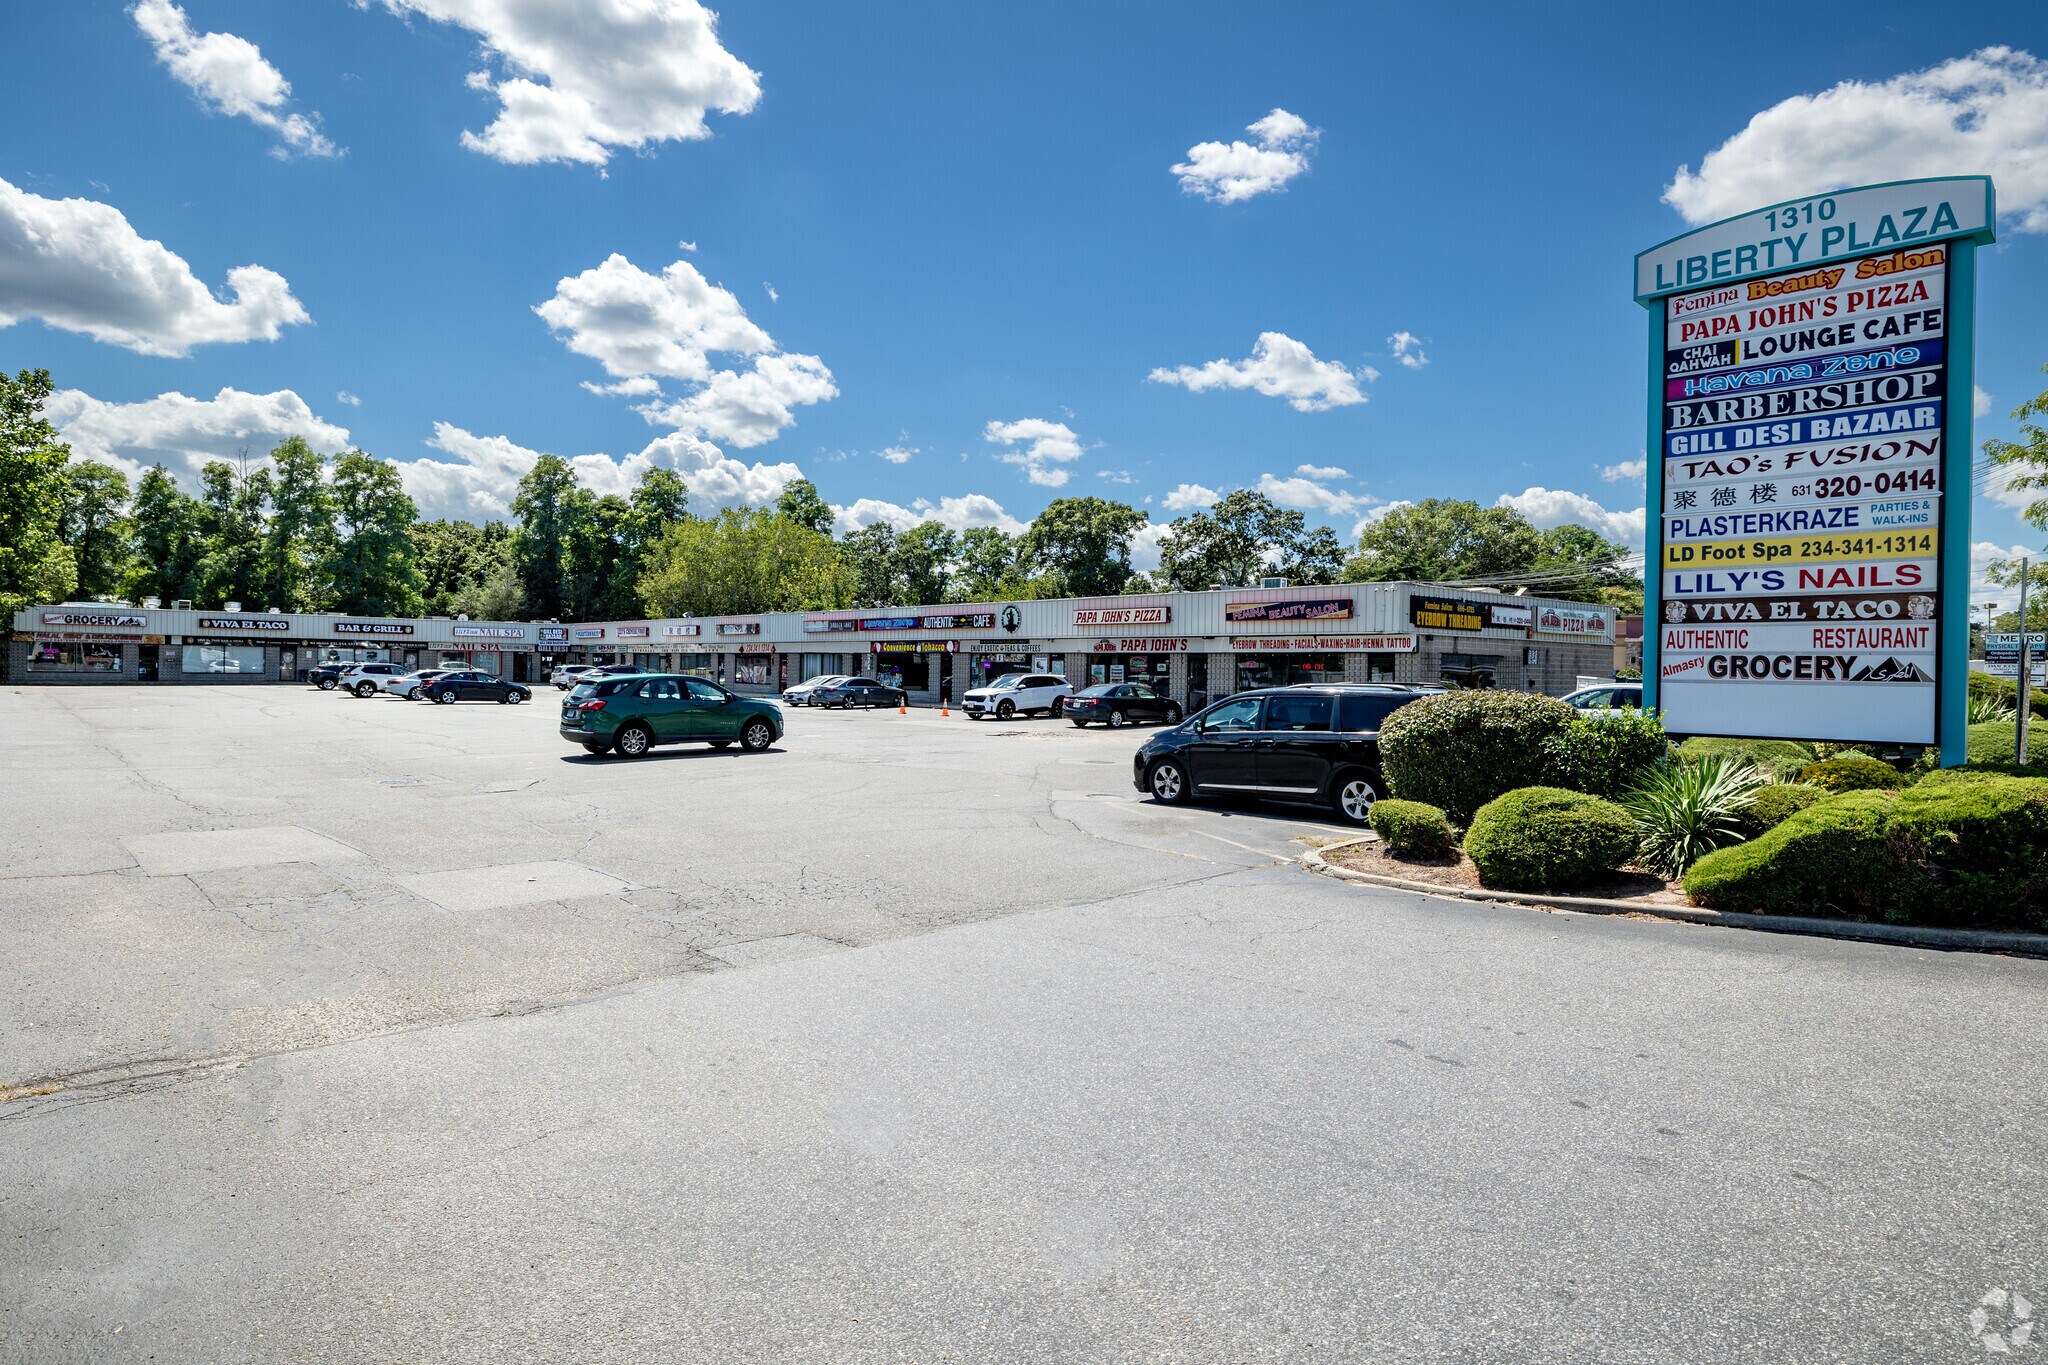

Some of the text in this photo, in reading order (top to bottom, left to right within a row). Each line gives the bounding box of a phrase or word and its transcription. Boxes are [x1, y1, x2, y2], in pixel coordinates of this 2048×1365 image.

[1765, 199, 1836, 232] 1310
[1656, 202, 1959, 291] LIBERTY PLAZA
[1672, 249, 1944, 315] Femina Beauty Salon
[1681, 280, 1930, 342] PAPA JOHN'S PIZZA
[1743, 309, 1942, 361] LOUNGE CAFE
[1682, 344, 1718, 360] CHAI
[1669, 353, 1731, 373] QAHWAH
[1684, 360, 1812, 396] Havana
[1670, 372, 1937, 429] BARBERSHOP
[1670, 406, 1936, 456] GILL DESI BAZAAR
[1681, 437, 1940, 480] TAO's FUSION
[1792, 469, 1936, 499] 631 320-0414
[1870, 501, 1931, 513] PARTIES &
[1671, 506, 1859, 539] PLASTERKRAZE
[1872, 513, 1929, 525] WALK-INS
[1669, 534, 1931, 562] LD Foot Spa 234-341-1314
[1675, 564, 1922, 594] LILY'S NAILS
[64, 614, 120, 626] GROCERY
[1076, 610, 1161, 623] PAPA JOHN'S PIZZA
[1233, 602, 1339, 620] FEMINA BEAUTY SALON
[1692, 600, 1901, 621] VIVA EL TACO
[212, 620, 287, 630] VIVA EL TACO
[338, 624, 403, 633] BAR & GRILL
[923, 616, 954, 629] AUTHENTIC
[973, 615, 990, 627] CAFE
[1417, 611, 1481, 630] EYEBROW THREADING
[1563, 618, 1585, 632] PIZZA
[479, 628, 501, 636] NAIL
[504, 629, 522, 637] SPA
[1666, 627, 1929, 650] AUTHENTIC RESTAURANT
[481, 643, 500, 651] SPA
[883, 642, 945, 652] Convenience Tobacco
[970, 644, 1041, 652] ENJOY EXOTIC TEAS & COFFEES
[1121, 638, 1188, 652] PAPA JOHN'S
[1232, 639, 1257, 649] EYEBROW
[1260, 639, 1290, 649] THREADING
[1295, 639, 1318, 649] FACIALS
[1387, 637, 1411, 648] TATTOO
[1662, 654, 1858, 681] Almasry GROCERY
